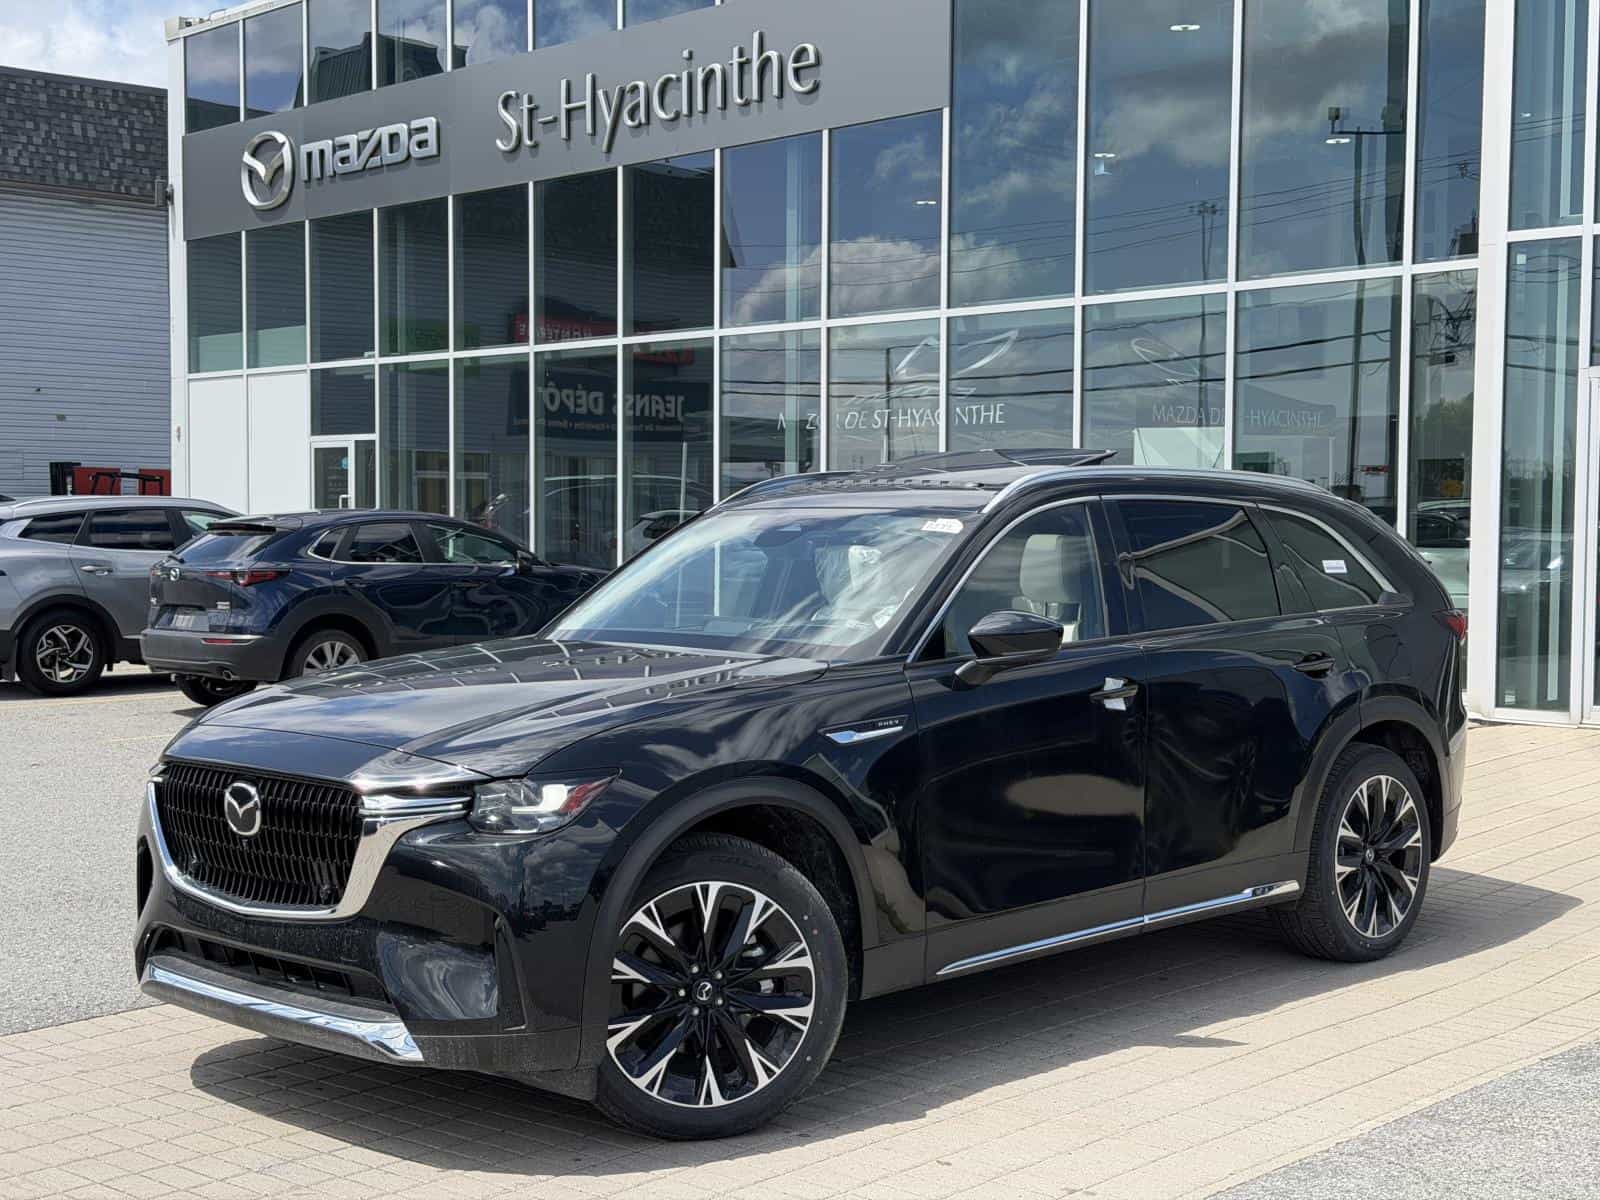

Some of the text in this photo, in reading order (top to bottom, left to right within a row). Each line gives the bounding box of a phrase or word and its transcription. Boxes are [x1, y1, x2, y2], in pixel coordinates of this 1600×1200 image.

[496, 30, 822, 153] St-Hyacinthe
[872, 403, 1005, 428] ST-HYACNTHE
[1152, 403, 1206, 425] MAZDA
